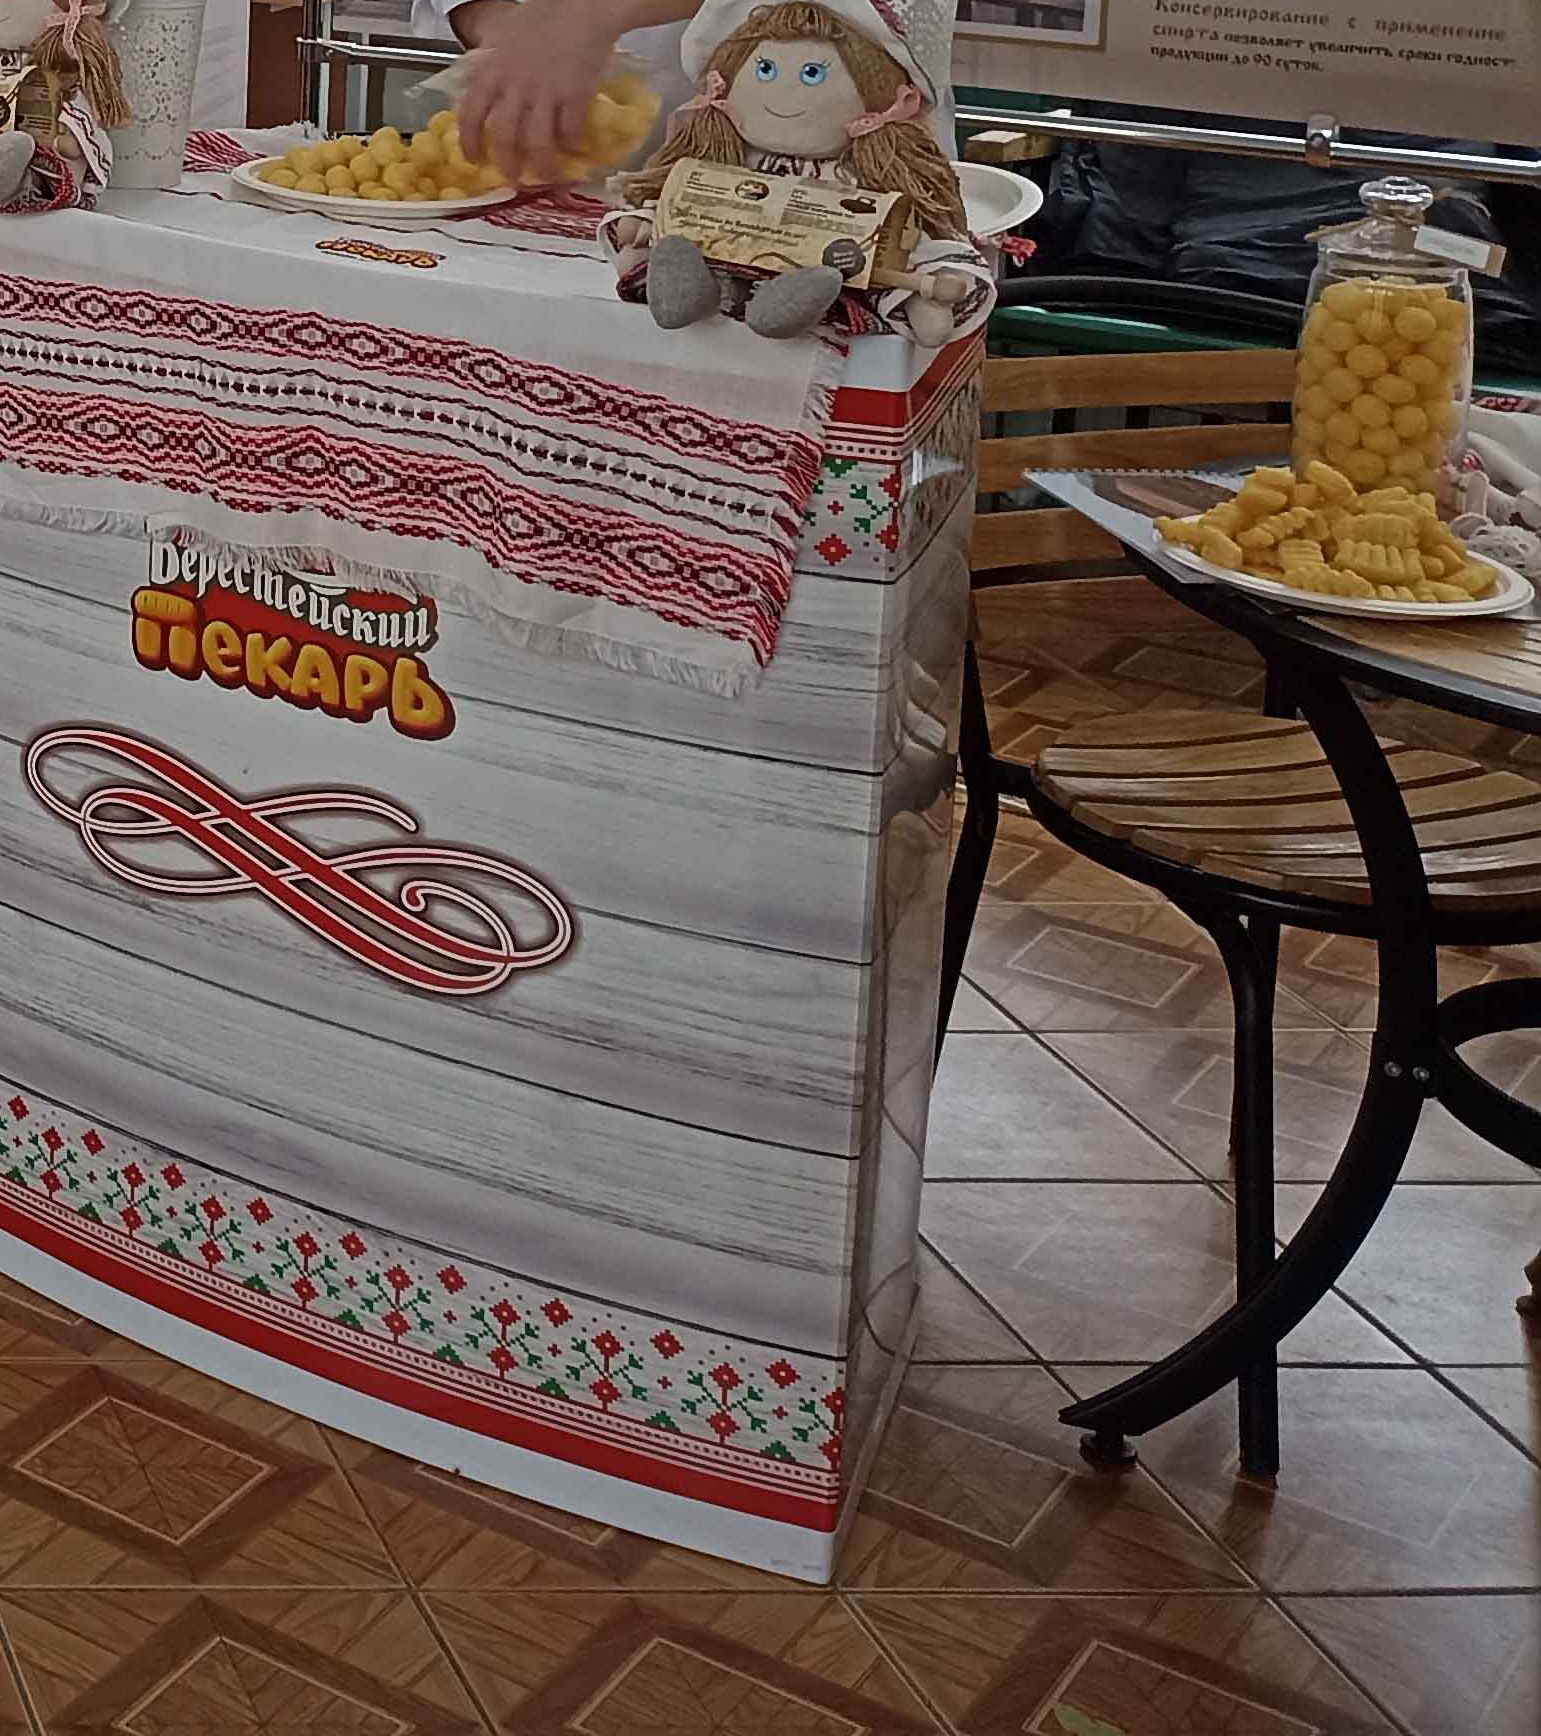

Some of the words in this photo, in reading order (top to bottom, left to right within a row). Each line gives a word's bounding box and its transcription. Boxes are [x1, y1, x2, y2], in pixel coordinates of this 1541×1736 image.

[1348, 17, 1356, 29] с
[1375, 19, 1507, 41] применение
[1151, 46, 1228, 62] продукции
[1231, 54, 1250, 64] до
[1152, 24, 1218, 40] спирта
[1223, 32, 1304, 48] позволяет
[1446, 53, 1517, 67] годност
